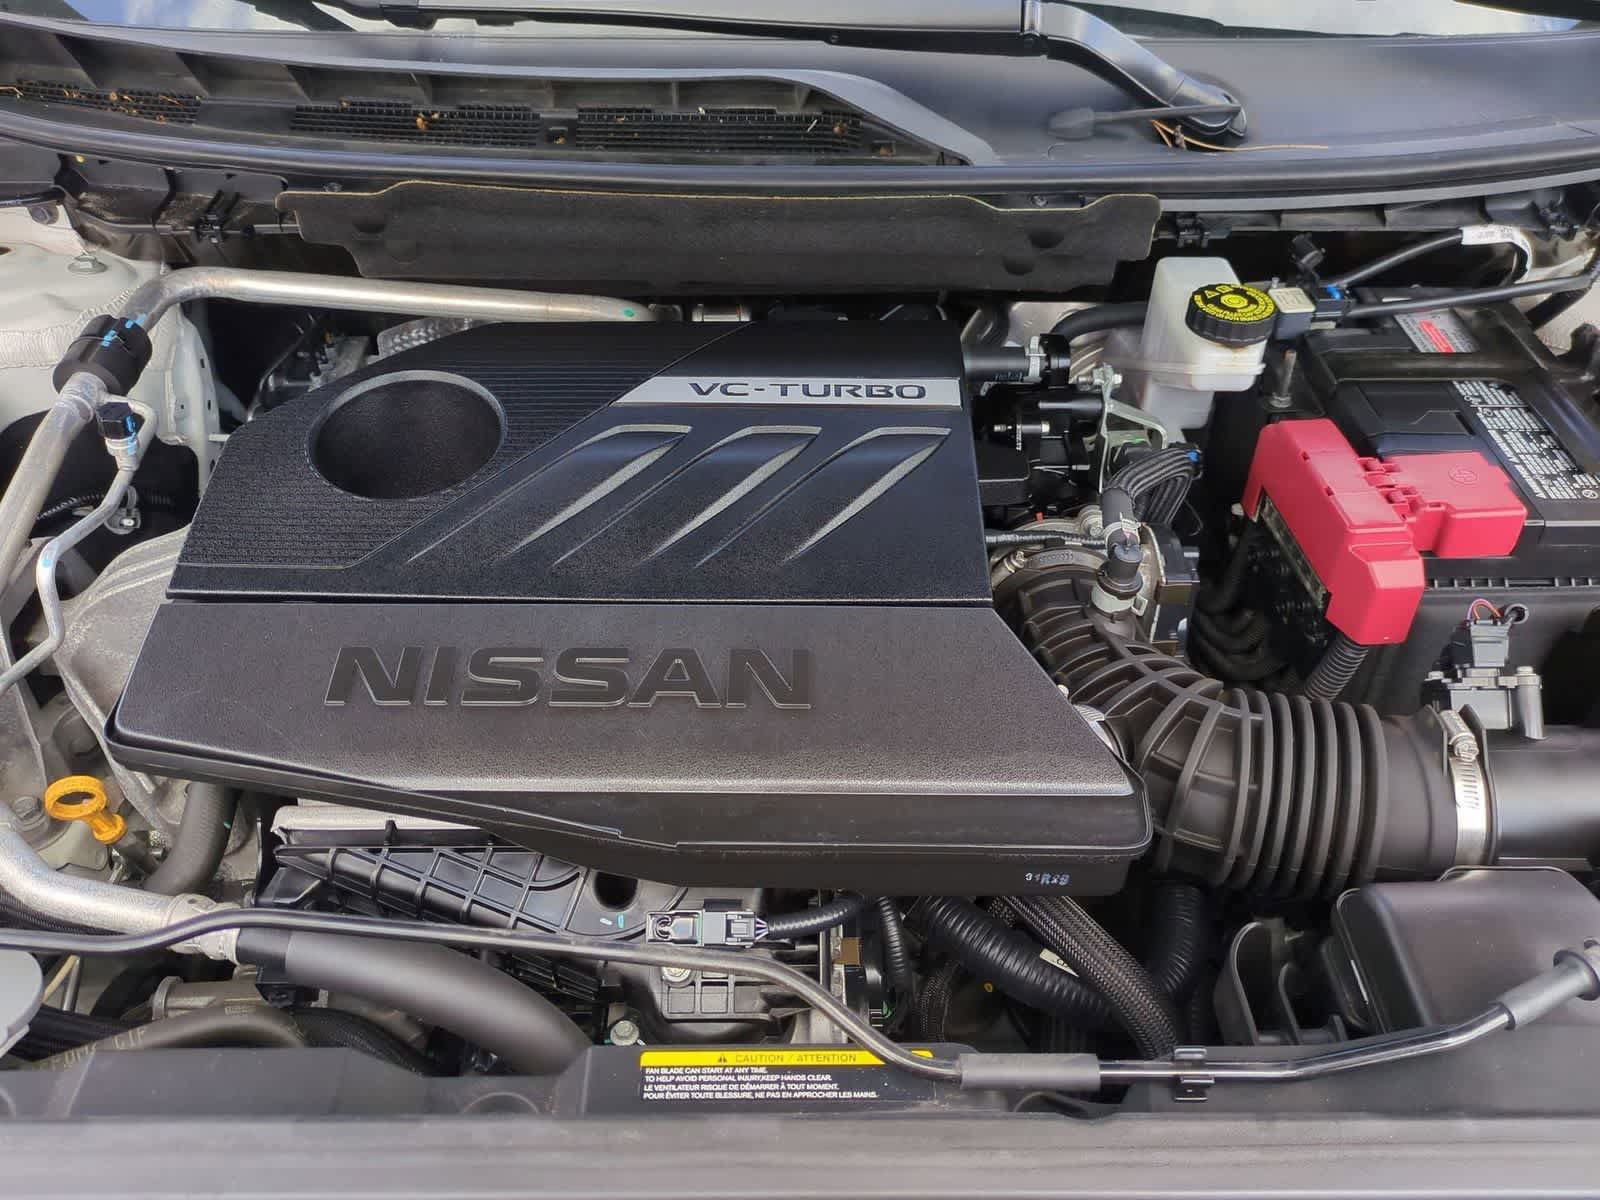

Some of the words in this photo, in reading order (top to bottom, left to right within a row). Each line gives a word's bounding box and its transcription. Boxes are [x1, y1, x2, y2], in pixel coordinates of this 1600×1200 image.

[689, 382, 927, 399] VC-TURBO
[323, 645, 813, 710] NISSAN
[736, 1055, 784, 1063] CAUTION
[796, 1055, 857, 1063] ATTENTION
[740, 1082, 779, 1090] DÉMARRER
[780, 1082, 786, 1090] À
[665, 1091, 690, 1099] ÉVITER
